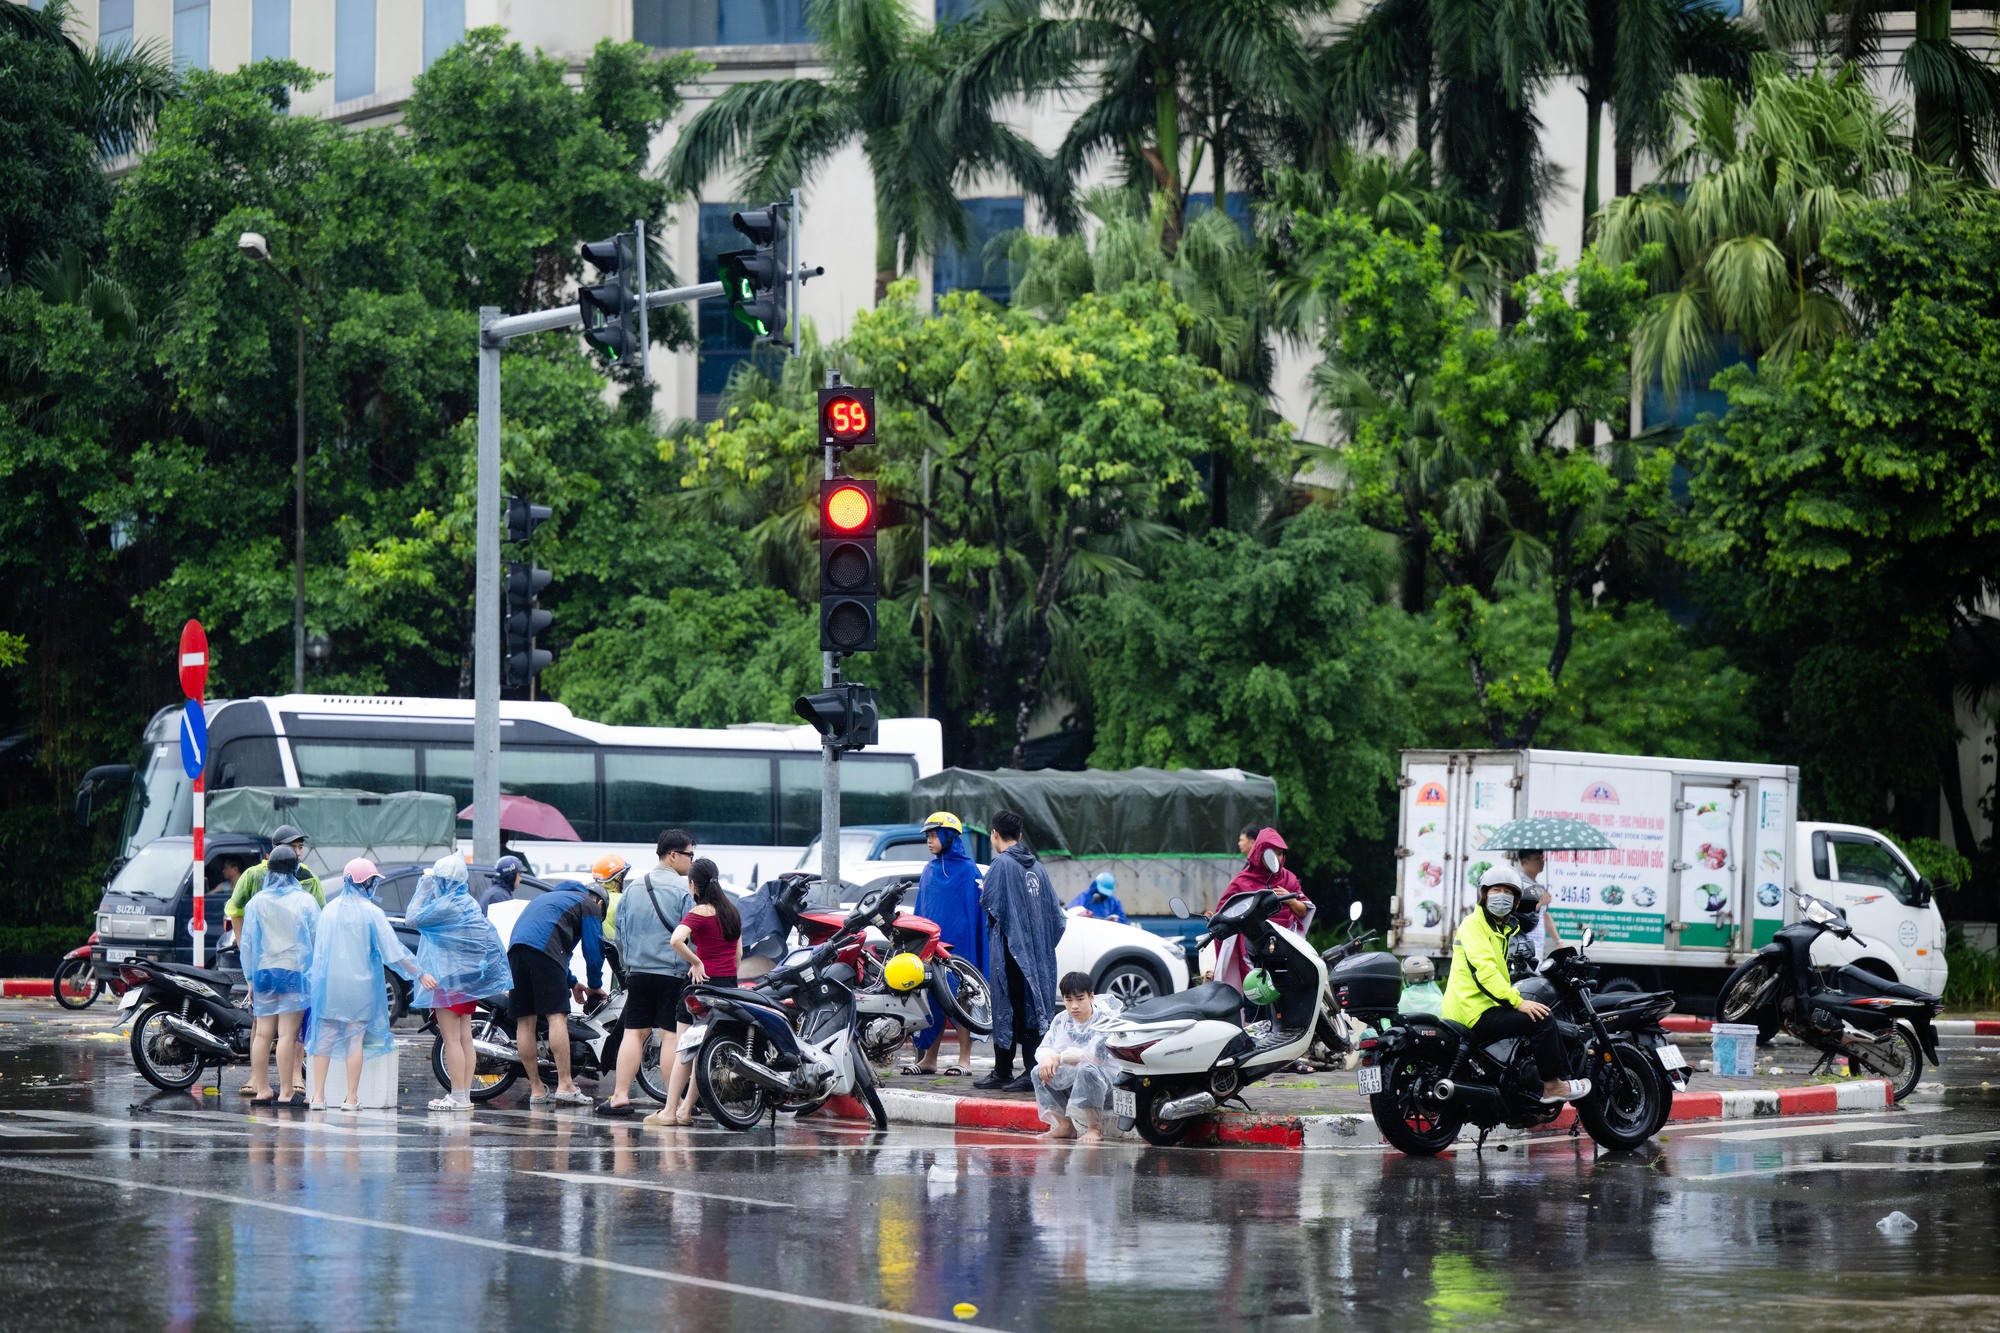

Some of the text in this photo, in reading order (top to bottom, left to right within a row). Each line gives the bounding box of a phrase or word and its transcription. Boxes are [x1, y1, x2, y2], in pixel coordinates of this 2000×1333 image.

[834, 402, 866, 431] 59
[1640, 833, 1664, 841] COMPANY
[1561, 885, 1591, 904] 245.45
[115, 904, 146, 915] SUZUKI
[1115, 1103, 1133, 1116] 2726
